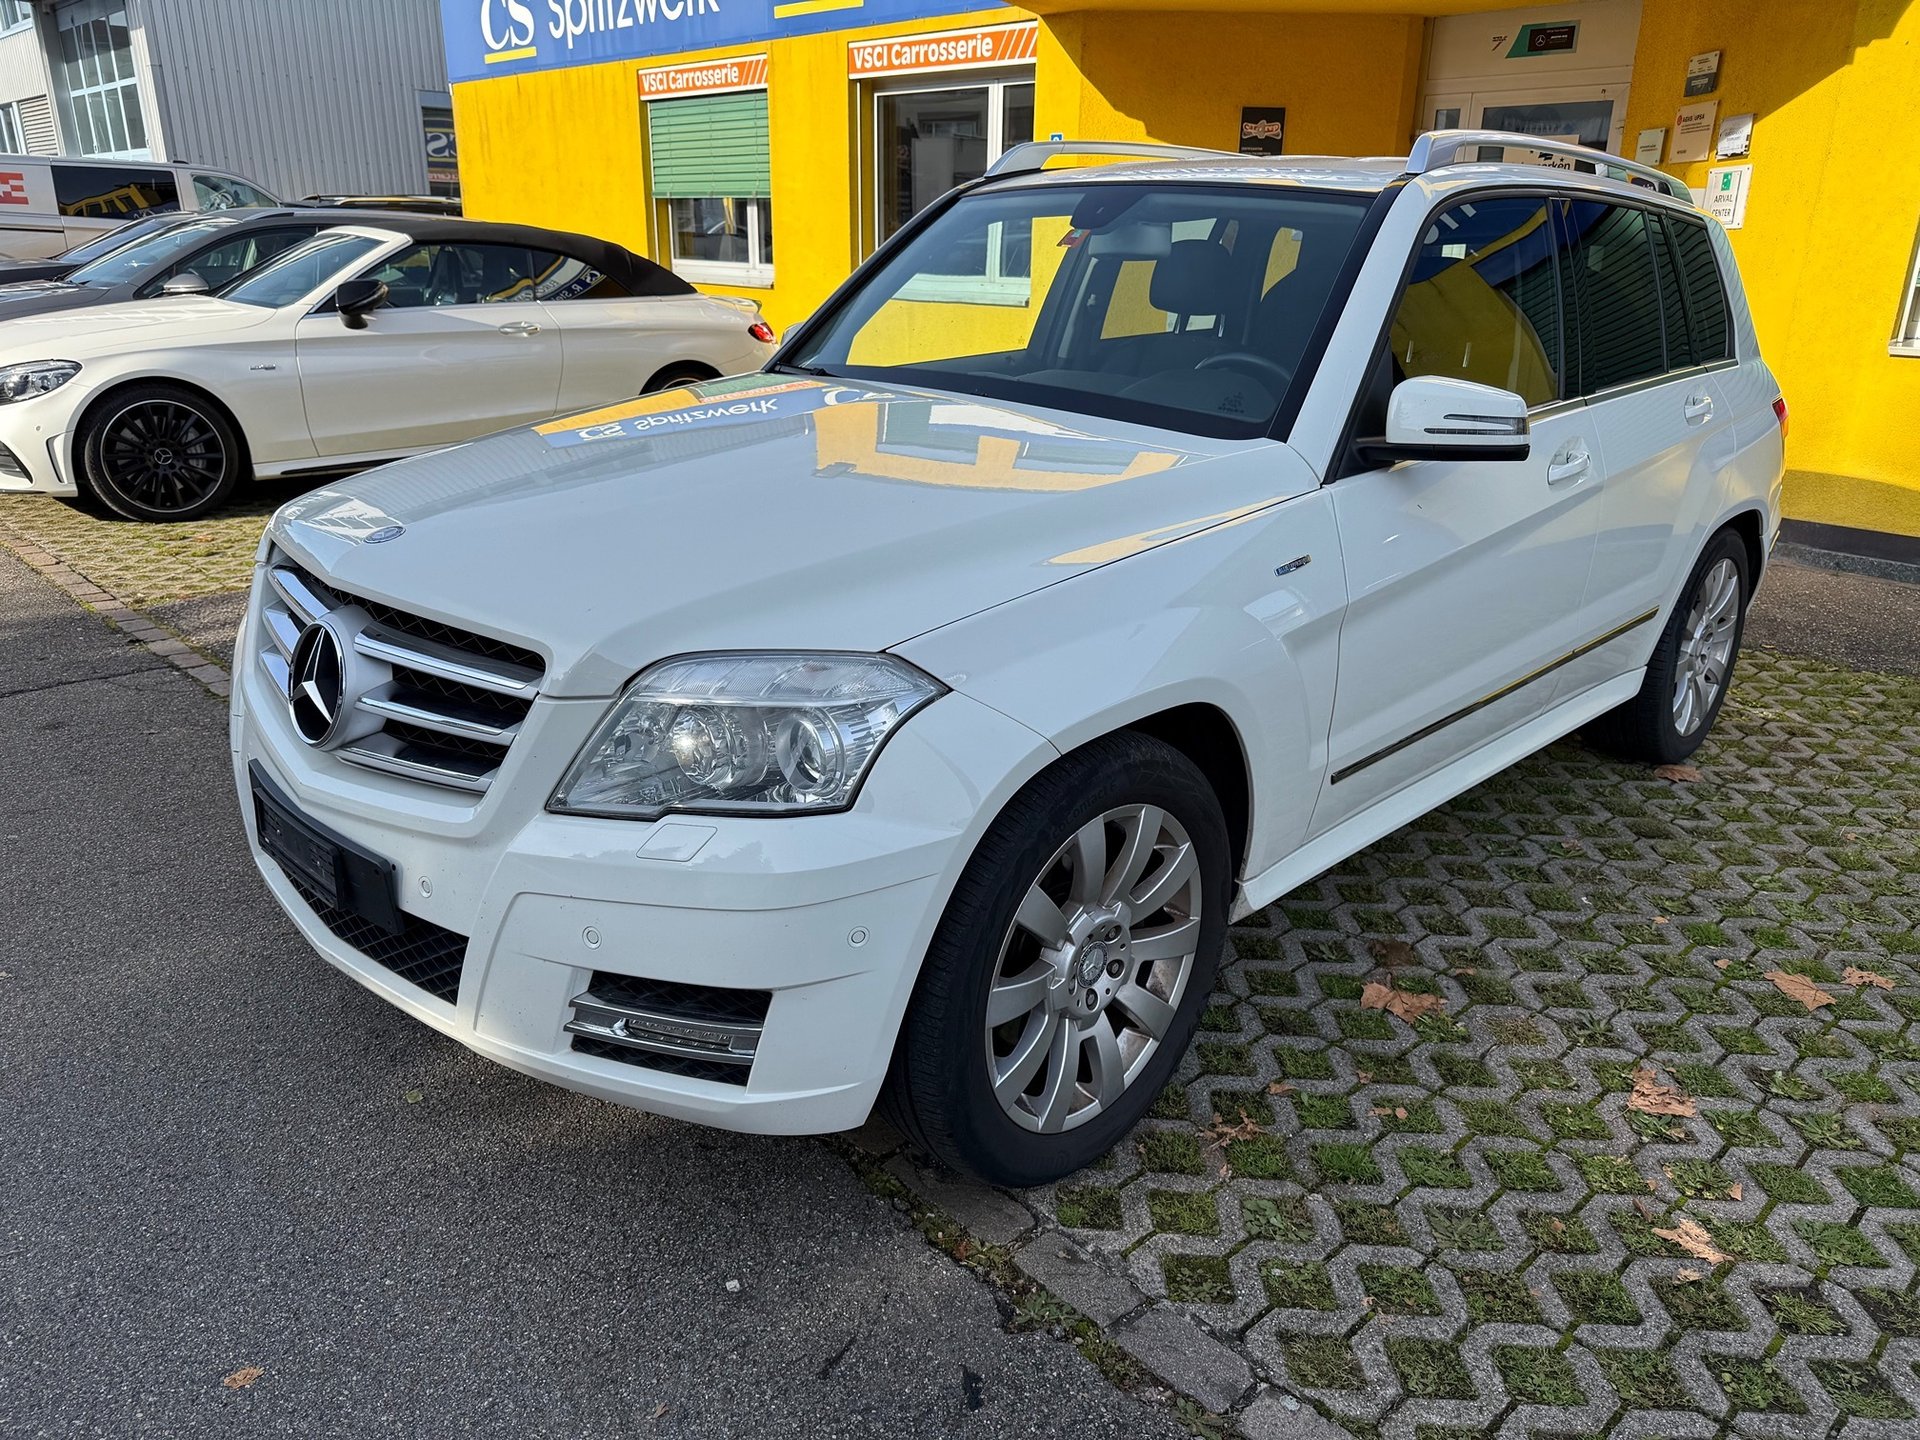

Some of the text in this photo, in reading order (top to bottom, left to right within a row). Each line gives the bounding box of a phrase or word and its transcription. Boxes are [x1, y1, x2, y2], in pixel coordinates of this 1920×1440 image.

[480, 0, 721, 50] CS Spritzw
[854, 34, 993, 69] VSCI Carrosserie
[642, 64, 739, 92] VSCI Carrosserie
[1711, 208, 1731, 217] CENTER
[1713, 194, 1733, 203] ARVAL
